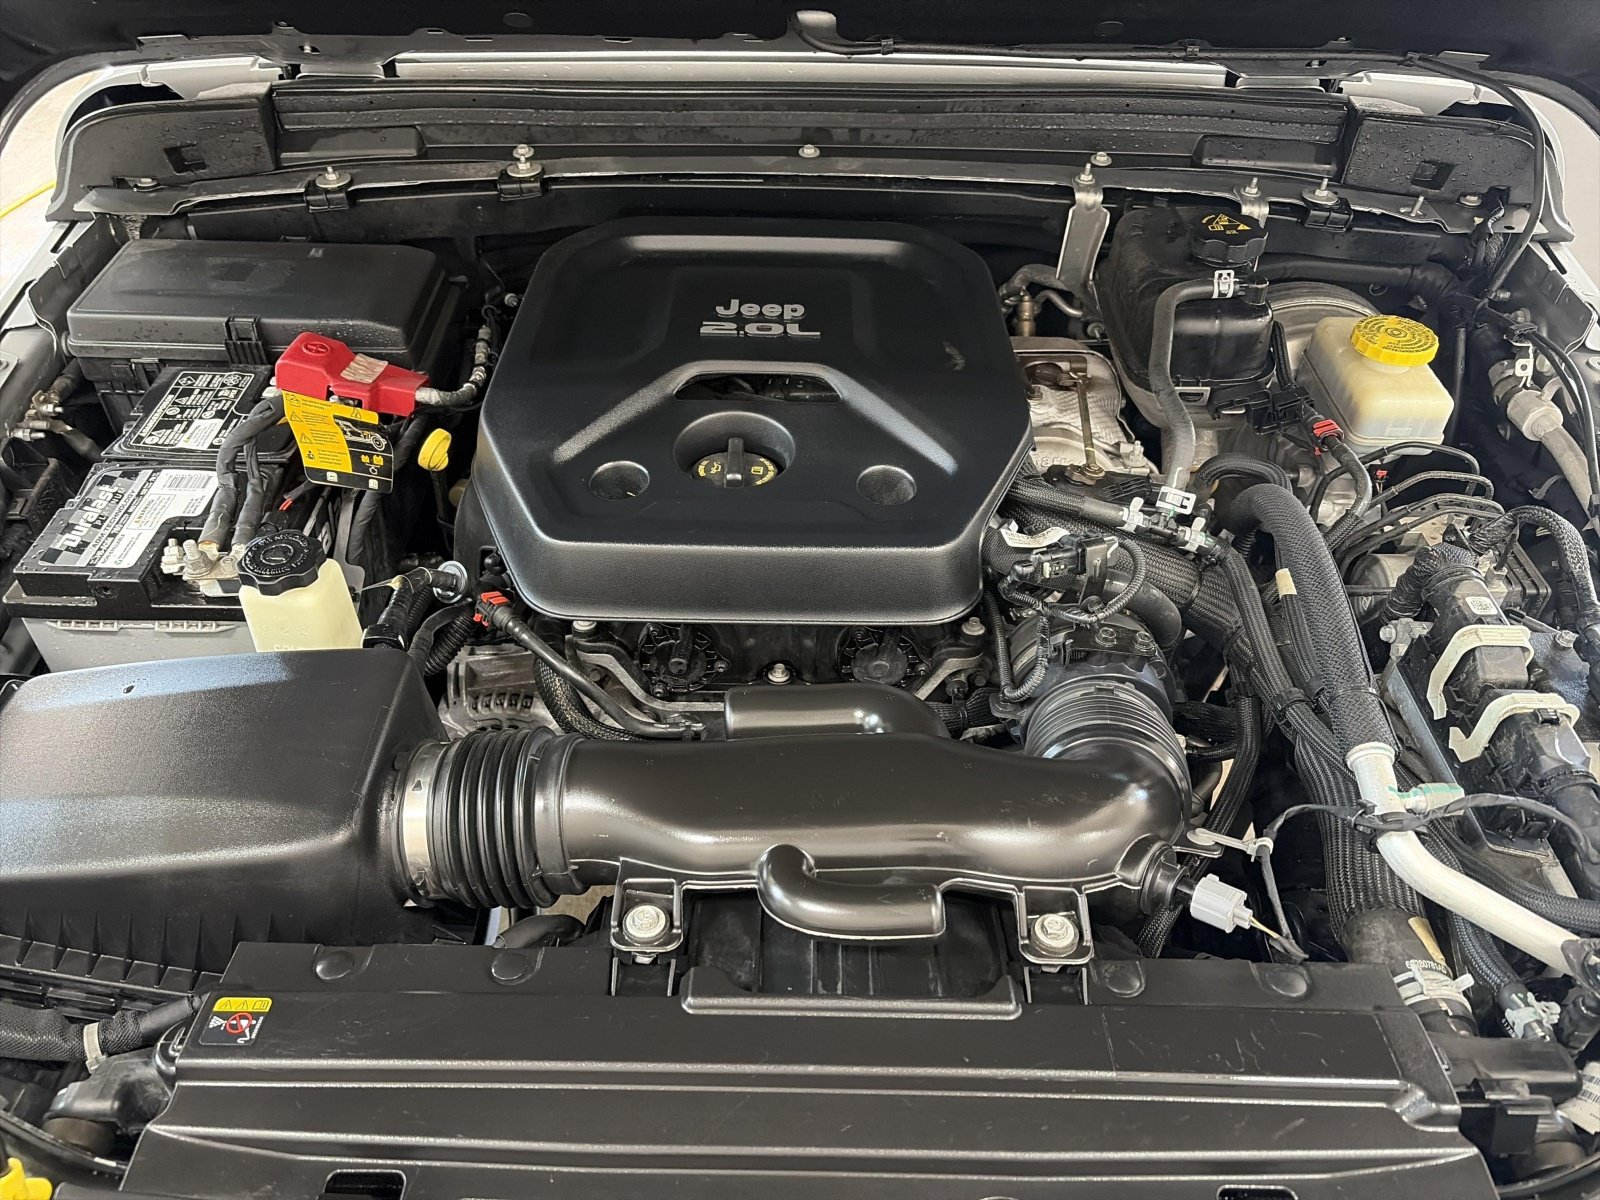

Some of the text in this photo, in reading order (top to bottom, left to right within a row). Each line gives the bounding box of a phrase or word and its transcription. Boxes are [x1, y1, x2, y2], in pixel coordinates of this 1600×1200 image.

[715, 298, 805, 321] Jeep
[700, 321, 821, 338] 2.0L
[51, 484, 118, 549] Duralast
[94, 487, 126, 526] PLATINUM
[104, 490, 136, 533] TECHNOLOGY
